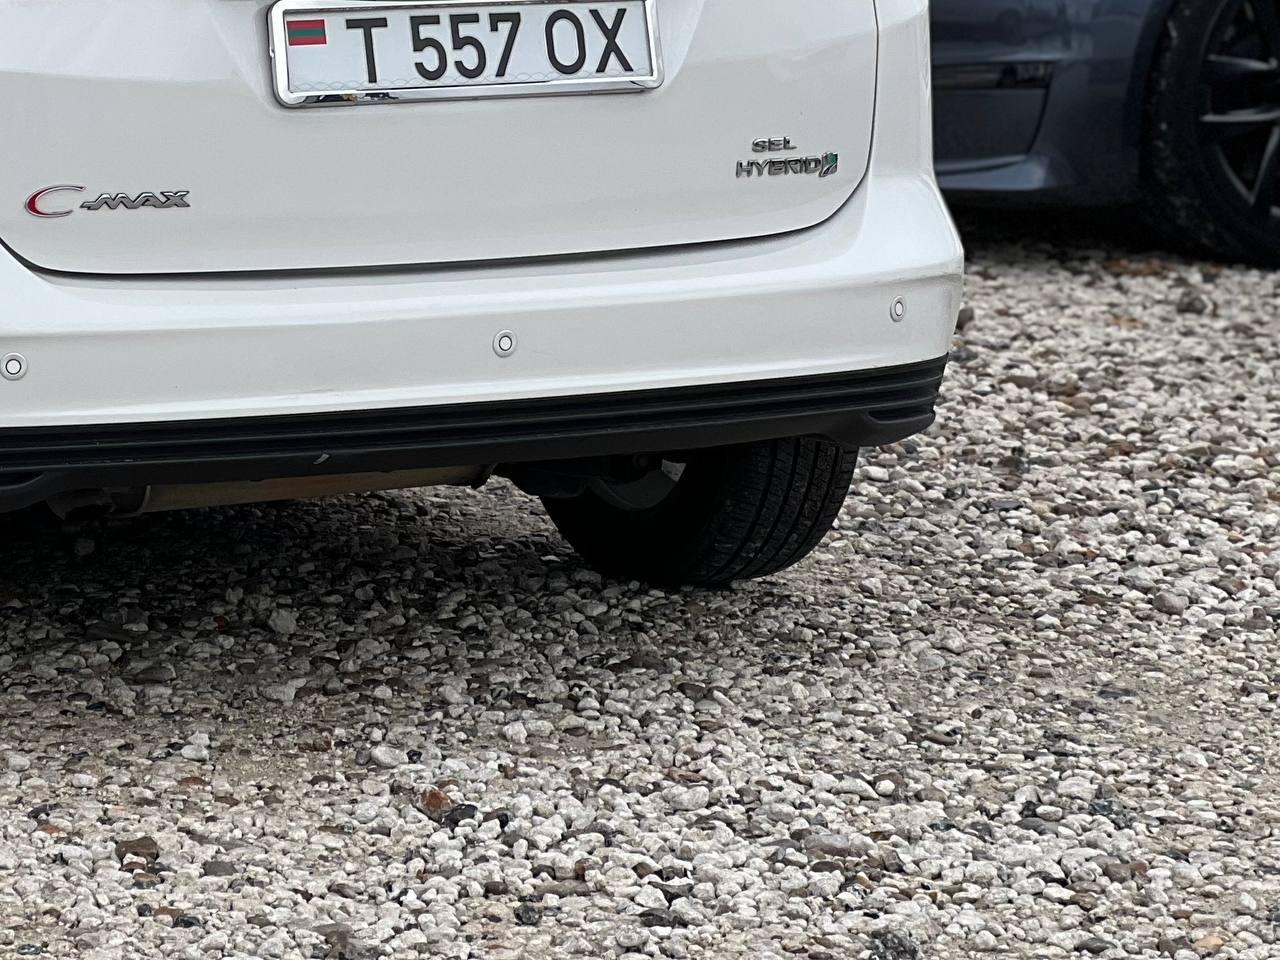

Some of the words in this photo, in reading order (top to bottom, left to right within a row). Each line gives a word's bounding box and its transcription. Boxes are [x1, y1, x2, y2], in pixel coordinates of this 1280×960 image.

[345, 16, 388, 84] T
[410, 11, 522, 81] 557
[544, 7, 634, 75] OX
[751, 136, 798, 153] SEL
[735, 155, 821, 178] HYBRID
